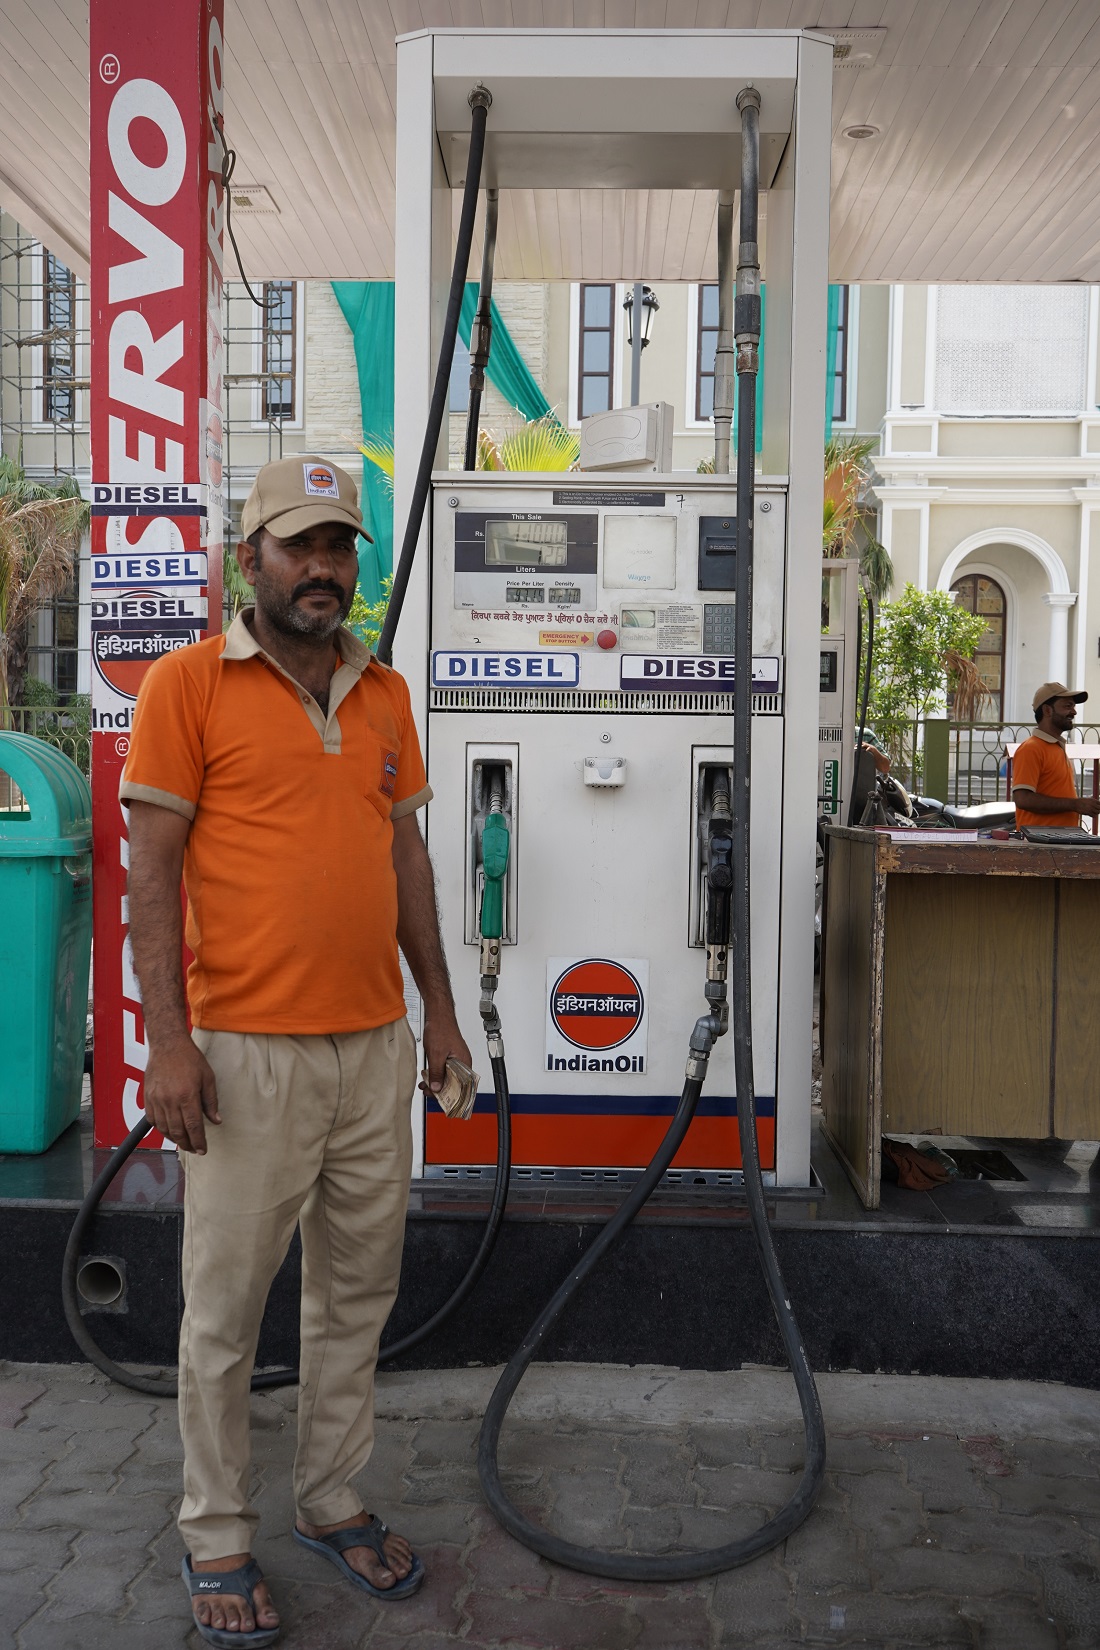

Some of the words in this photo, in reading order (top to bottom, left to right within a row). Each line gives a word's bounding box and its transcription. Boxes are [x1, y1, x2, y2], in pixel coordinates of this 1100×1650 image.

[94, 486, 198, 504] DIESEL
[94, 558, 199, 579] DIESEL
[91, 600, 194, 617] DIESEL
[448, 657, 563, 677] DIESEL
[643, 659, 756, 678] DIESE
[824, 763, 833, 811] PTROL
[556, 994, 638, 1013] इंडियनऑयल
[547, 1053, 644, 1073] IndianOil
[198, 1581, 222, 1589] MAJOR
